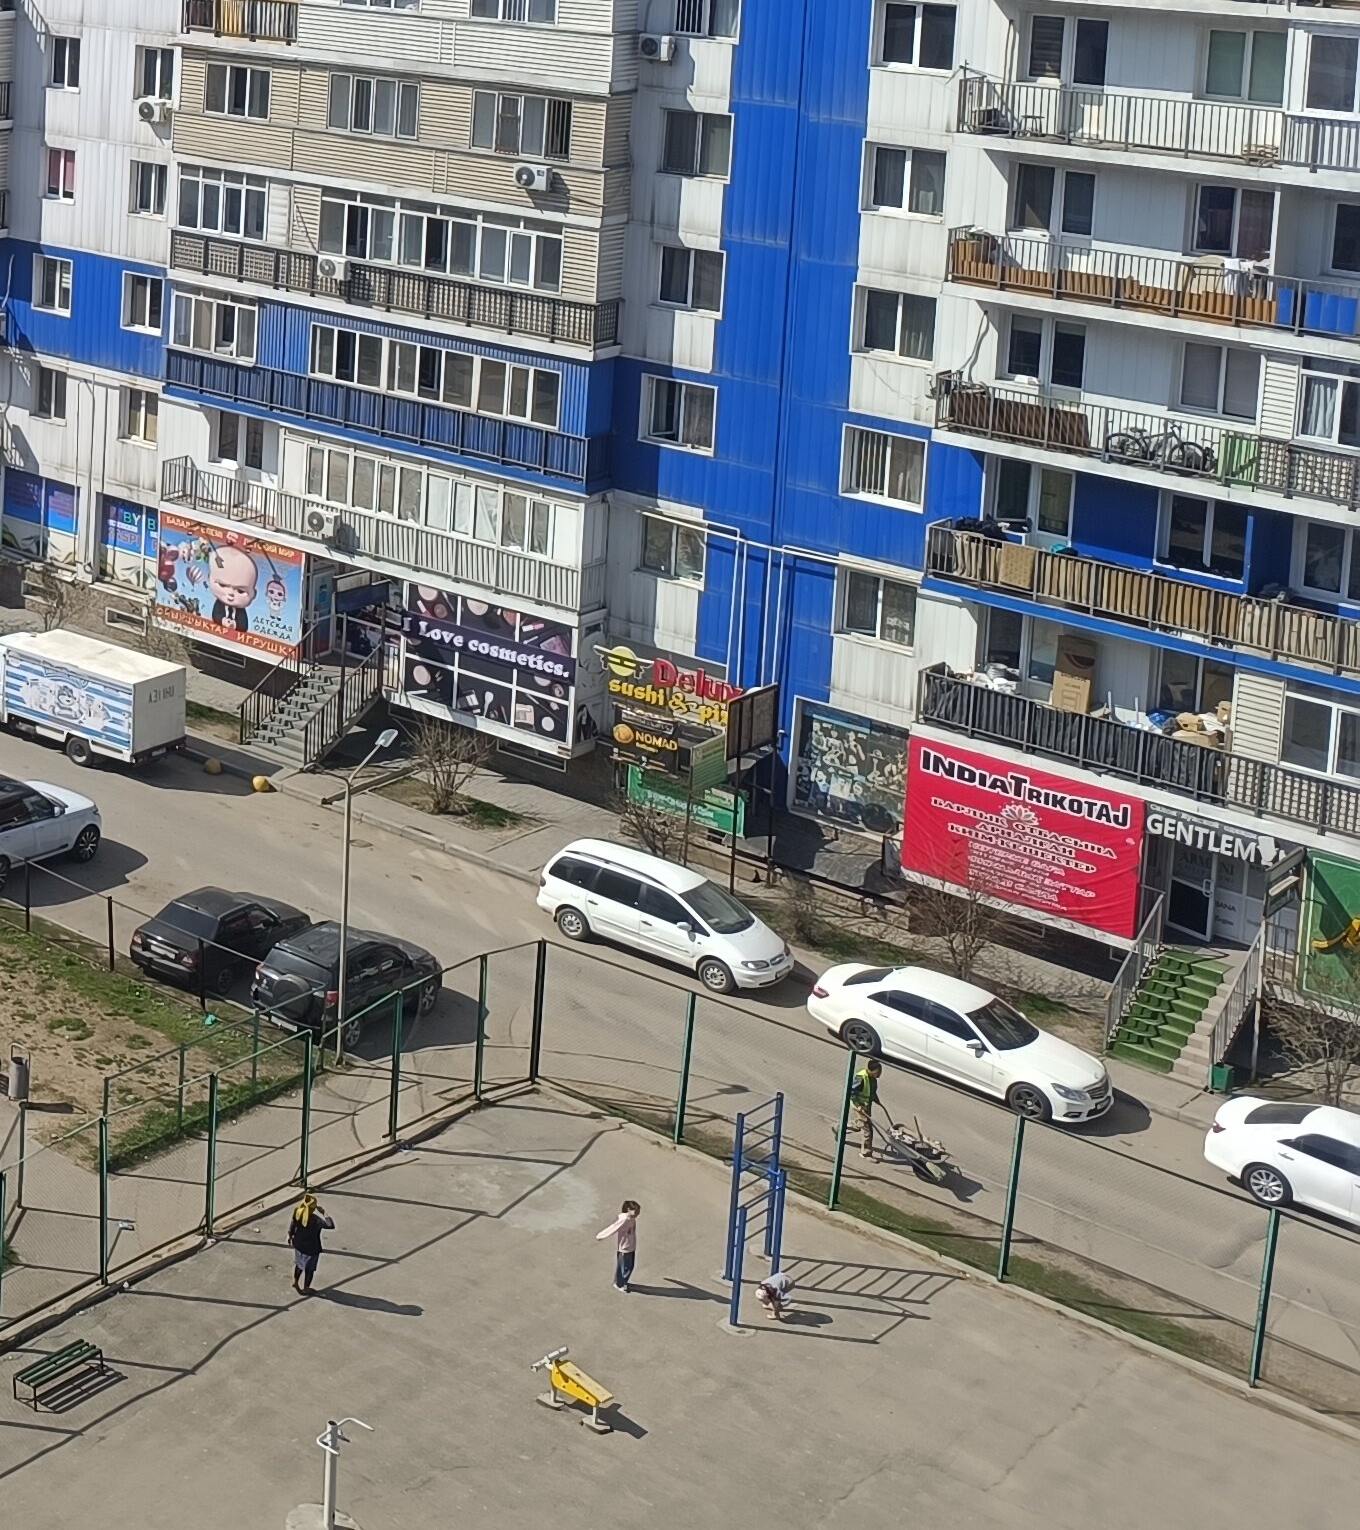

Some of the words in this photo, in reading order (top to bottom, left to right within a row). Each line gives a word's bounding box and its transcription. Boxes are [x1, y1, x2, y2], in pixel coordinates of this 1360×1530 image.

[253, 615, 294, 633] ДЕТСКАЯ
[253, 625, 291, 641] ОДЕЖДА
[419, 620, 464, 648] Love
[467, 638, 570, 678] cosmetics.
[608, 677, 667, 707] sushi
[635, 730, 678, 751] NOMAD
